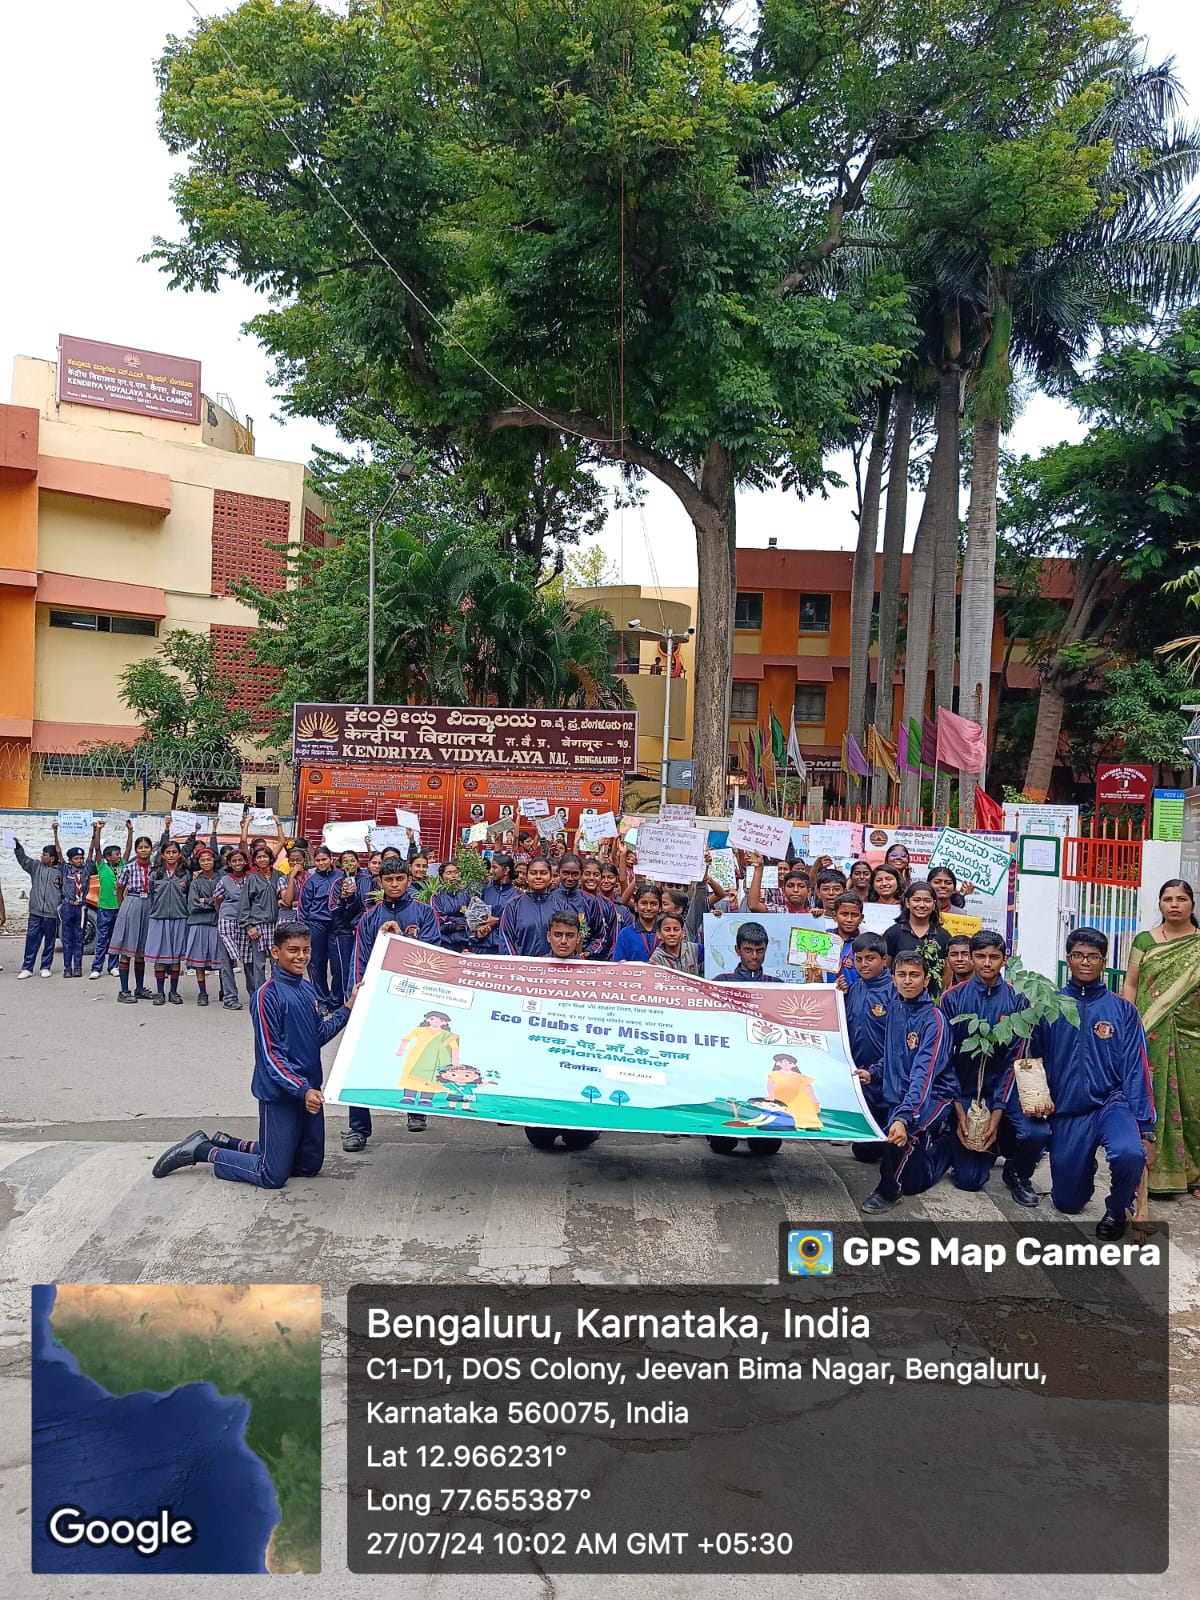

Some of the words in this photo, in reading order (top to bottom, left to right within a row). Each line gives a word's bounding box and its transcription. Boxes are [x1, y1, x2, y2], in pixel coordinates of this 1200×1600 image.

[68, 377, 103, 390] KENDRIYA
[104, 384, 143, 398] VIDYALAYA
[166, 396, 192, 406] CAMPUS
[446, 710, 536, 734] ವಿದ್ಯಾಲಯ
[344, 724, 408, 744] केन्द्रीय
[417, 726, 496, 746] विद्यालय
[342, 745, 433, 760] KENDRIYA
[439, 748, 544, 764] VIDYALAYA
[458, 977, 522, 993] KENDRIYA
[525, 987, 597, 999] VIDYALAYA
[601, 992, 626, 1001] NAL
[630, 993, 684, 1007] CAMPUS,
[687, 999, 762, 1018] BENGALURU
[491, 1010, 522, 1024] Eco
[528, 1015, 579, 1032] Clubs
[586, 1023, 612, 1036] for
[618, 1026, 687, 1044] Mission
[694, 1034, 730, 1048] LiFE
[785, 1029, 821, 1043] LiFE
[548, 1046, 669, 1068] #Plant4Mother
